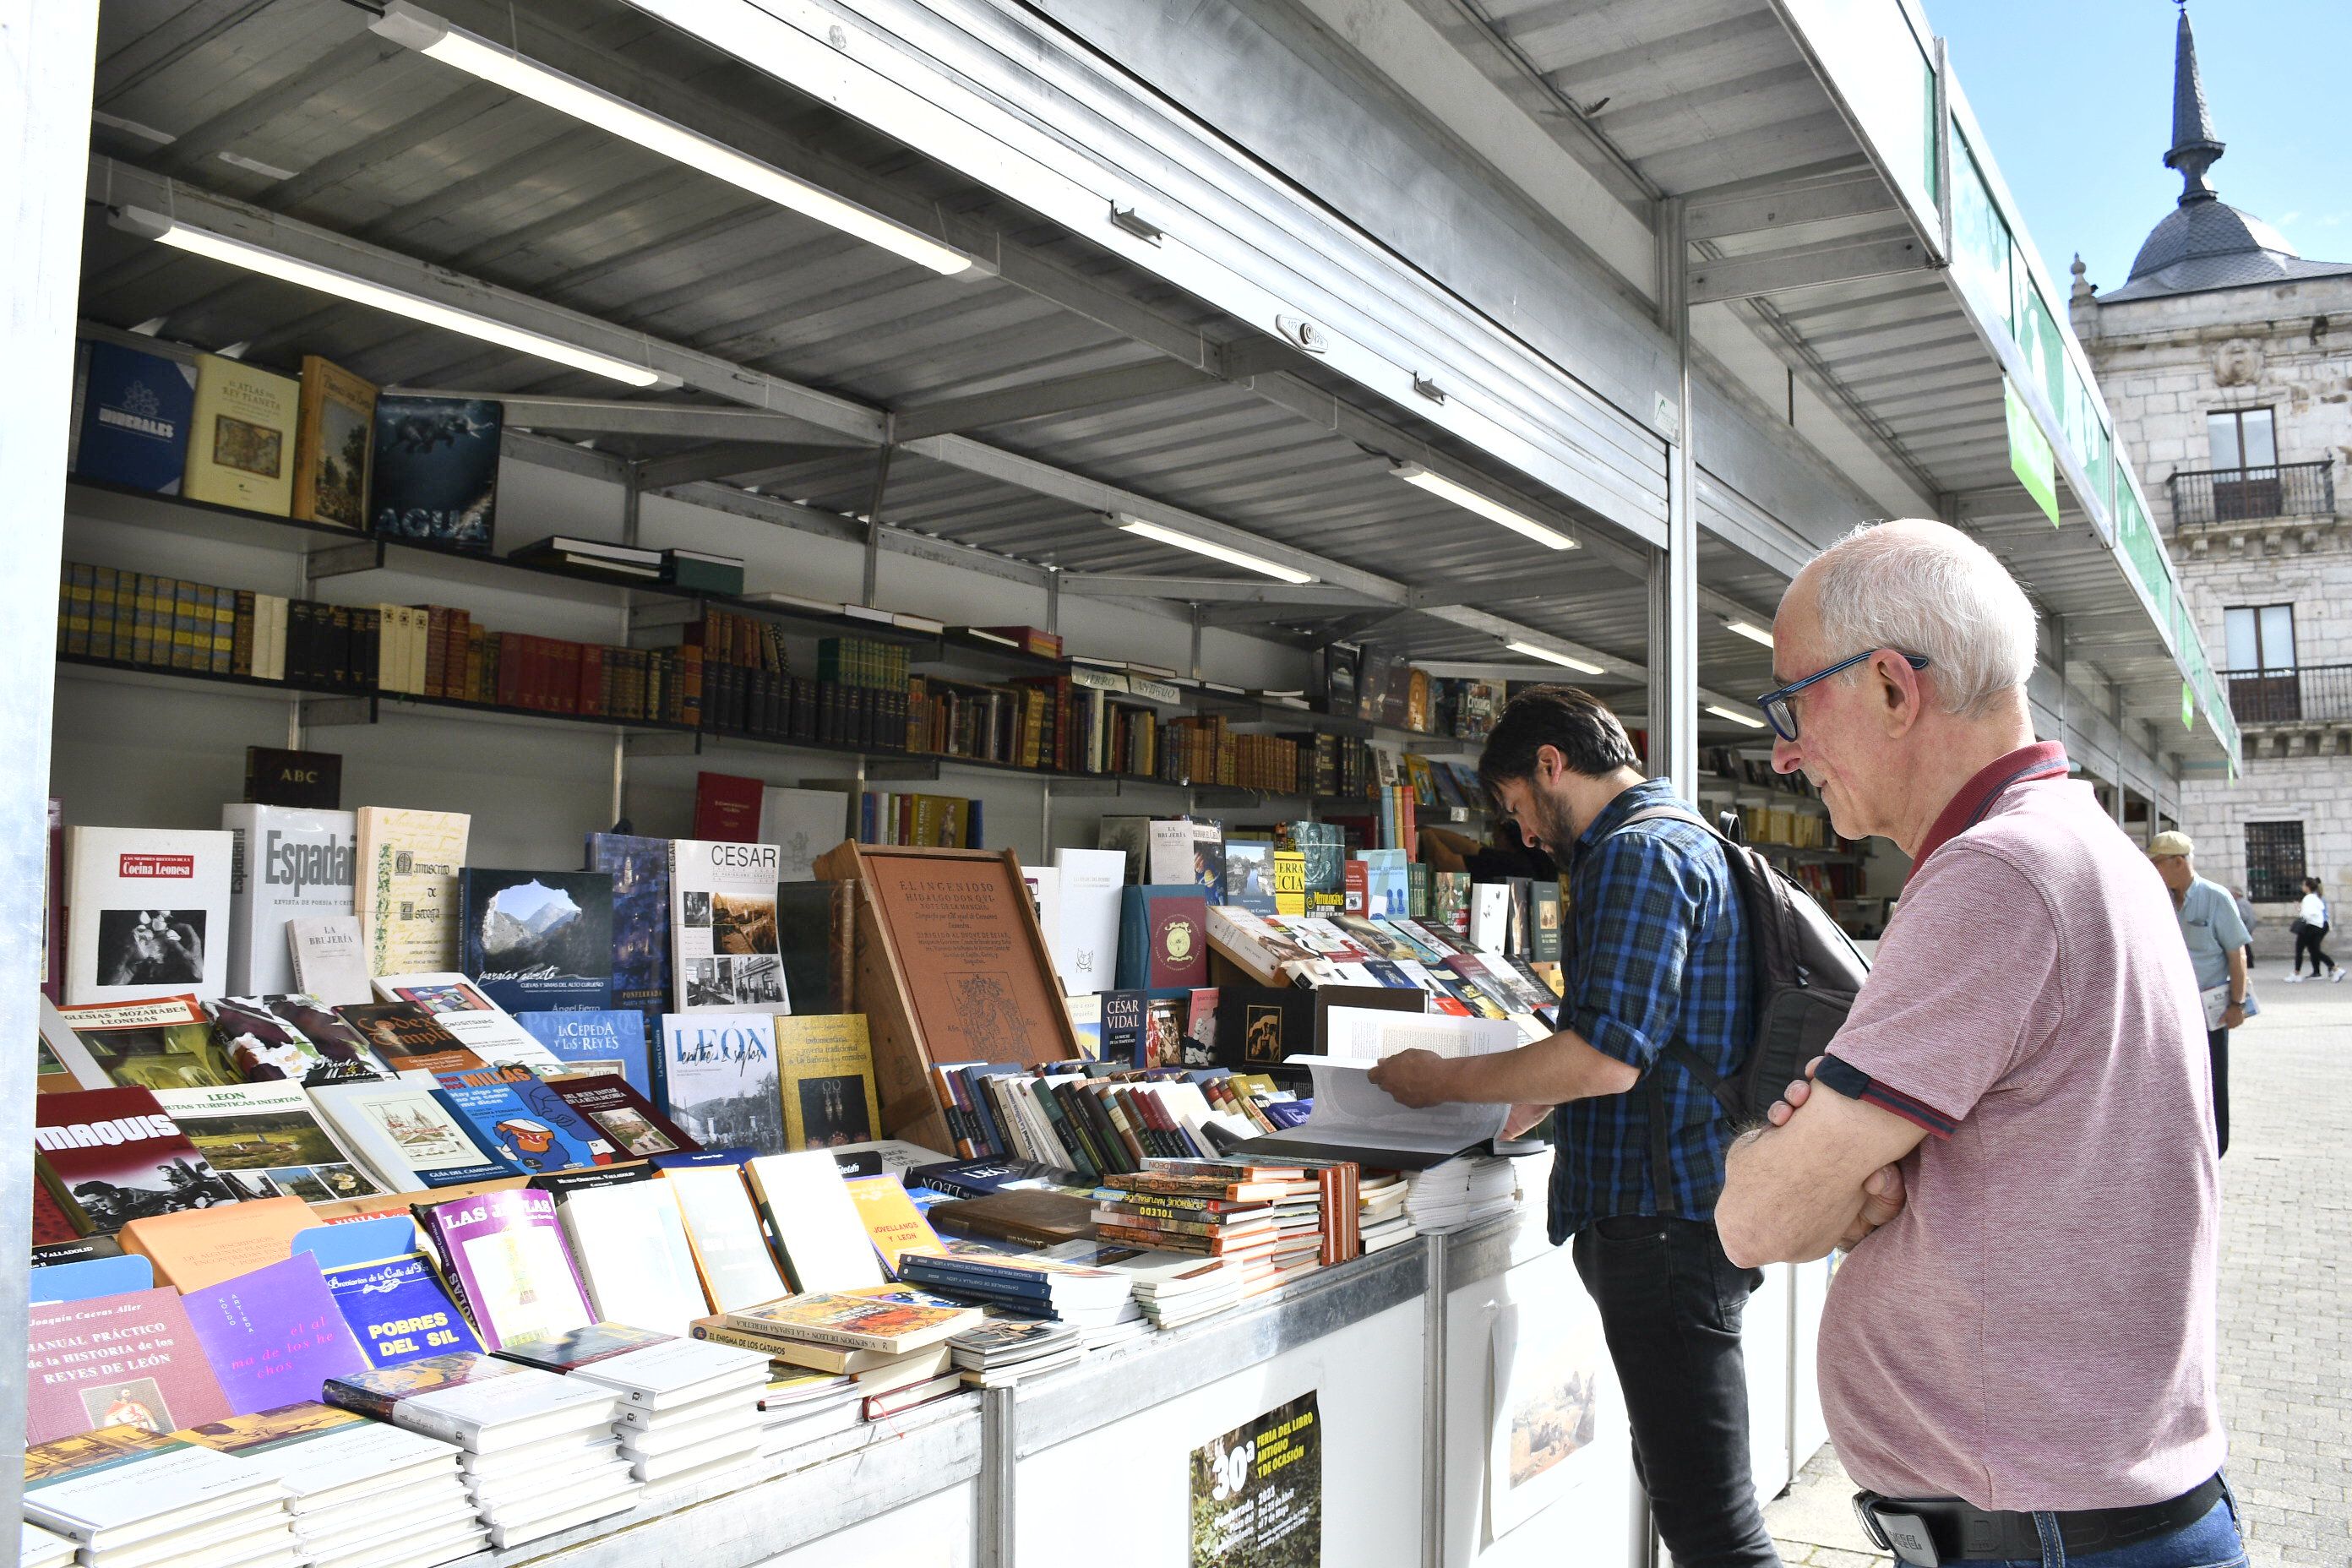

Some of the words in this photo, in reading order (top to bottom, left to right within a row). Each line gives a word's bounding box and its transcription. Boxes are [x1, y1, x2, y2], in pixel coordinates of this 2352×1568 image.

[237, 383, 264, 396] ATLAS
[222, 386, 239, 398] REY
[242, 393, 280, 411] PLANETA
[376, 508, 487, 541] AGUA
[1135, 681, 1175, 699] ANTIGUO
[280, 768, 318, 784] ABC
[711, 845, 776, 868] CESAR
[122, 861, 153, 874] Cocina
[155, 862, 190, 875] Leonesa
[1274, 863, 1304, 874] UERRA
[899, 879, 914, 889] EL
[920, 882, 994, 892] INGENIOSO
[1274, 875, 1304, 890] UCIA
[906, 893, 951, 901] HIDALGO
[1314, 891, 1344, 906] MITOLOGÍAS
[324, 926, 335, 934] LA
[308, 934, 354, 945] BRUJERÍA
[64, 1012, 112, 1021] GLESIAS
[119, 1006, 188, 1017] MOZARABES
[553, 1003, 576, 1011] Ángel
[1107, 998, 1139, 1014] CÉSAR
[101, 1015, 158, 1025] LEONESAS
[1107, 1015, 1139, 1029] VIDAL
[558, 1026, 567, 1037] LA
[567, 1021, 614, 1037] CEPEDA
[583, 1037, 619, 1050] REYES
[674, 1021, 767, 1062] LEÓN
[825, 1044, 858, 1053] tradicional
[459, 1066, 532, 1089] MILLÁS
[195, 1100, 255, 1109] TURISTICAS
[259, 1095, 302, 1105] INEDITAS
[207, 1092, 246, 1102] LEON
[35, 1114, 182, 1151] MAQUIS
[428, 1170, 448, 1179] GUÍA
[465, 1165, 506, 1175] CAMINANTE
[1135, 1195, 1165, 1206] NATURAL
[1168, 1198, 1196, 1208] PARQUE
[444, 1206, 487, 1231] LAS
[1139, 1206, 1173, 1218] TOLEDO
[874, 1221, 918, 1234] JOVELLANOS
[897, 1233, 917, 1241] LEON
[40, 1246, 94, 1259] VALLADOLID
[368, 1274, 377, 1282] de
[378, 1273, 384, 1282] la
[75, 1309, 113, 1320] Cuevas
[117, 1304, 142, 1314] Aller
[91, 1320, 166, 1342] PRÁCTICO
[290, 1323, 305, 1337] el
[311, 1315, 326, 1331] al
[368, 1311, 448, 1340] POBRES
[736, 1320, 768, 1331] HERETICA
[770, 1325, 795, 1336] ESPAÑA
[378, 1339, 419, 1358] DEL
[427, 1327, 460, 1348] SIL
[717, 1334, 738, 1345] ENIGMA
[739, 1338, 747, 1347] DE
[747, 1340, 759, 1349] LOS
[760, 1339, 786, 1356] CÁTAROS
[840, 1336, 868, 1347] SENDON
[27, 1358, 42, 1369] de
[45, 1355, 60, 1367] la
[63, 1344, 134, 1364] HISTORIA
[138, 1341, 153, 1352] de
[155, 1337, 175, 1348] los
[231, 1357, 253, 1370] ma
[262, 1348, 279, 1362] de
[287, 1338, 310, 1353] los
[317, 1331, 335, 1346] he
[43, 1368, 97, 1386] REYES
[101, 1363, 126, 1376] DE
[128, 1353, 172, 1372] LEÓN
[257, 1360, 293, 1379] chos
[1256, 1429, 1277, 1449] FERIA
[1278, 1422, 1292, 1439] DEL
[1292, 1411, 1314, 1432] LIBRO
[1257, 1438, 1289, 1464] ANTIGUO
[1257, 1467, 1263, 1479] Y
[1263, 1462, 1271, 1475] DE
[1271, 1445, 1304, 1470] OCASIÓN
[1258, 1484, 1276, 1505] 2023
[1214, 1500, 1255, 1531] Ponferrada
[1275, 1505, 1289, 1521] Mayo
